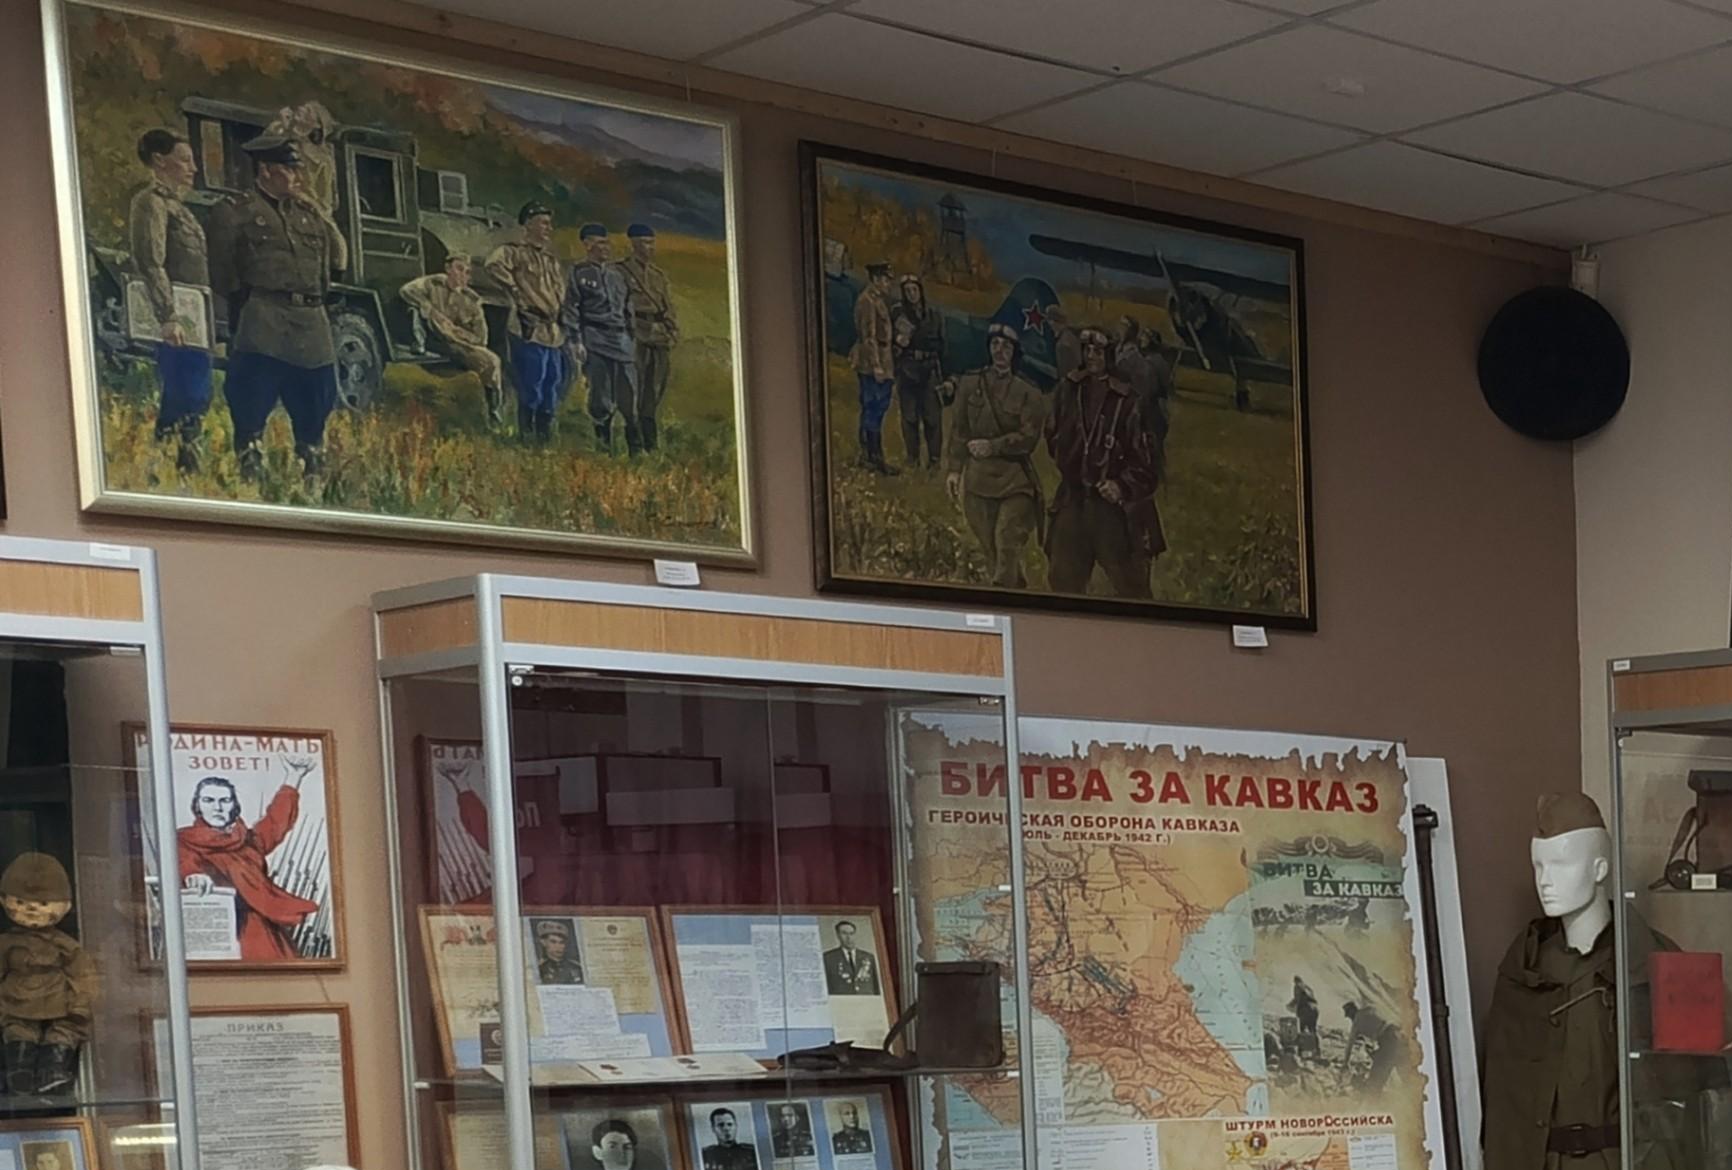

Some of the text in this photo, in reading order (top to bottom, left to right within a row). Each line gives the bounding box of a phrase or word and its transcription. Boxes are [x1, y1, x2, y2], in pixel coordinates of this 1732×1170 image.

[137, 733, 319, 754] РДИНА-МАТЬ
[188, 756, 270, 772] ЗОВЕТ!
[940, 761, 1379, 814] БИТВА ЗА КАВКАЗ
[928, 810, 1240, 834] ГЕРОИЧСКАЯ ОБОРОНА КАВКАЗА
[1062, 830, 1122, 843] ДЕКАБРЬ
[1125, 833, 1152, 843] 1942
[1263, 862, 1333, 880] БИТВА
[1313, 882, 1403, 898] ЗА КАВКАЗ
[226, 1021, 285, 1033] ПРИКАЗ
[1226, 1121, 1277, 1132] ШТУРМ
